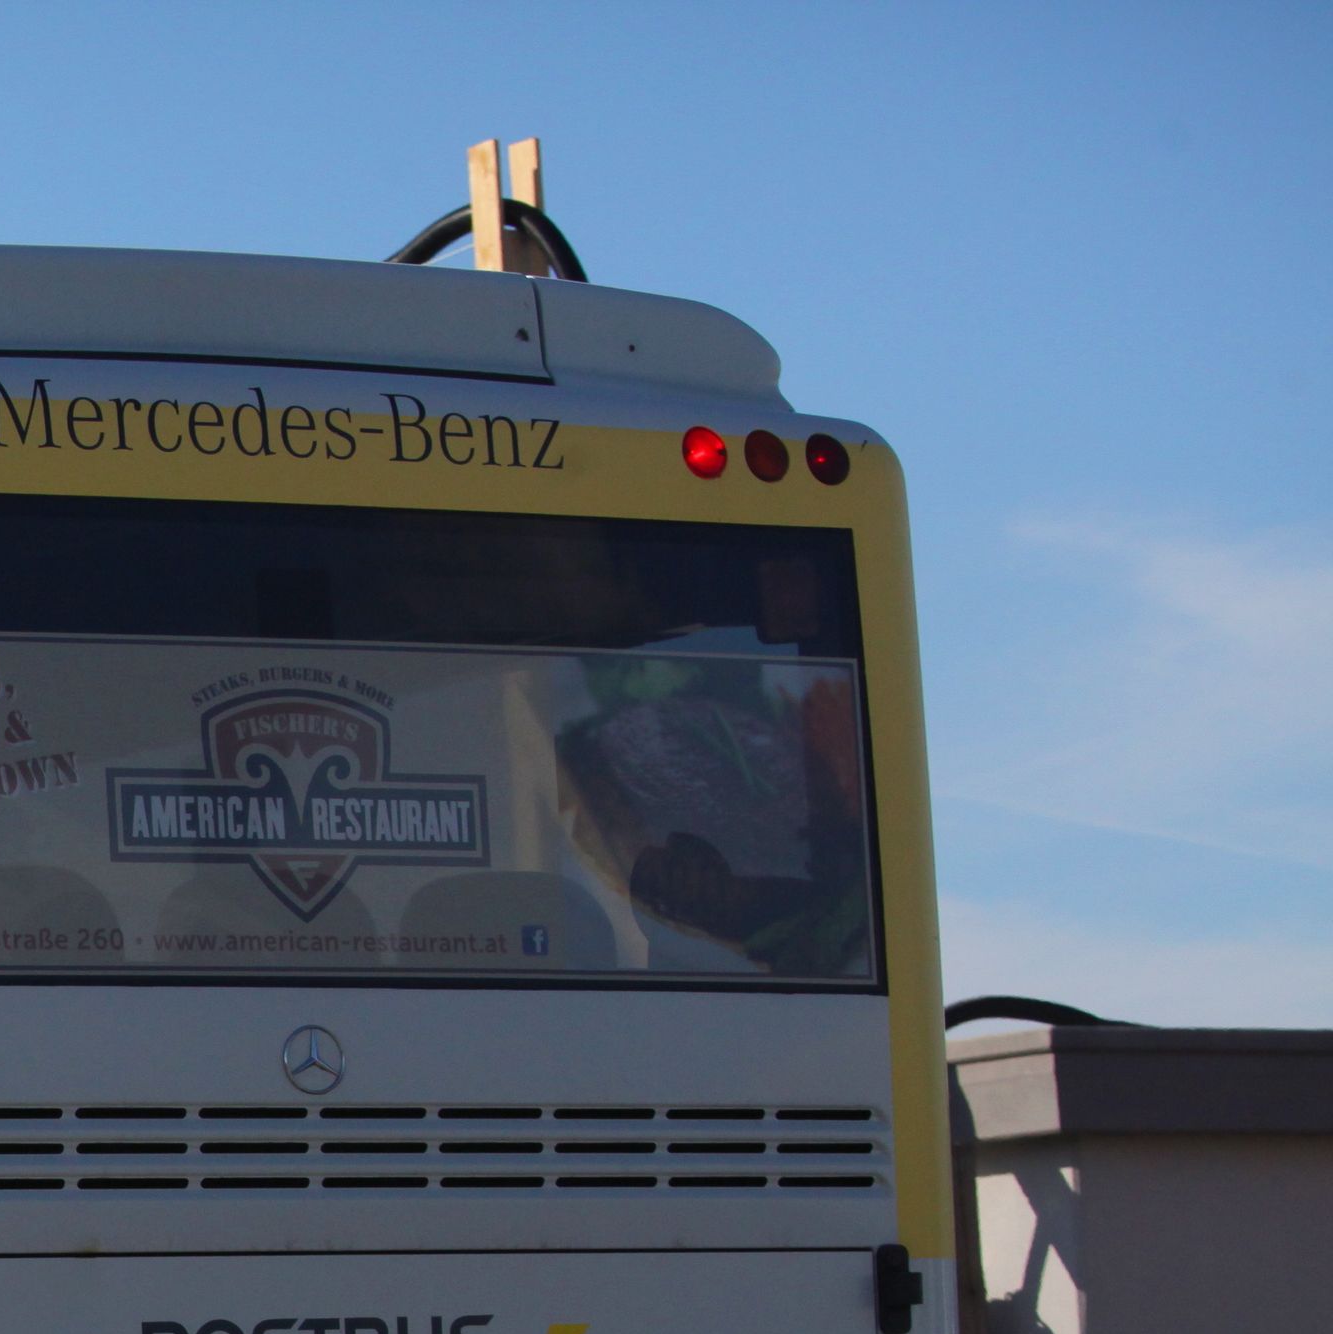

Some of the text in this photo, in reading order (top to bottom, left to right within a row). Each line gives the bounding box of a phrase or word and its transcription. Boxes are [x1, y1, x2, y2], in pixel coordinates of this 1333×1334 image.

[190, 666, 396, 712] STEAKS, BURGERS & MORE
[4, 709, 34, 744] &
[233, 712, 360, 743] FISCHER'S
[312, 798, 471, 843] RESTAURANT
[77, 929, 125, 952] 260
[153, 930, 508, 955] www.american-restaurant.at
